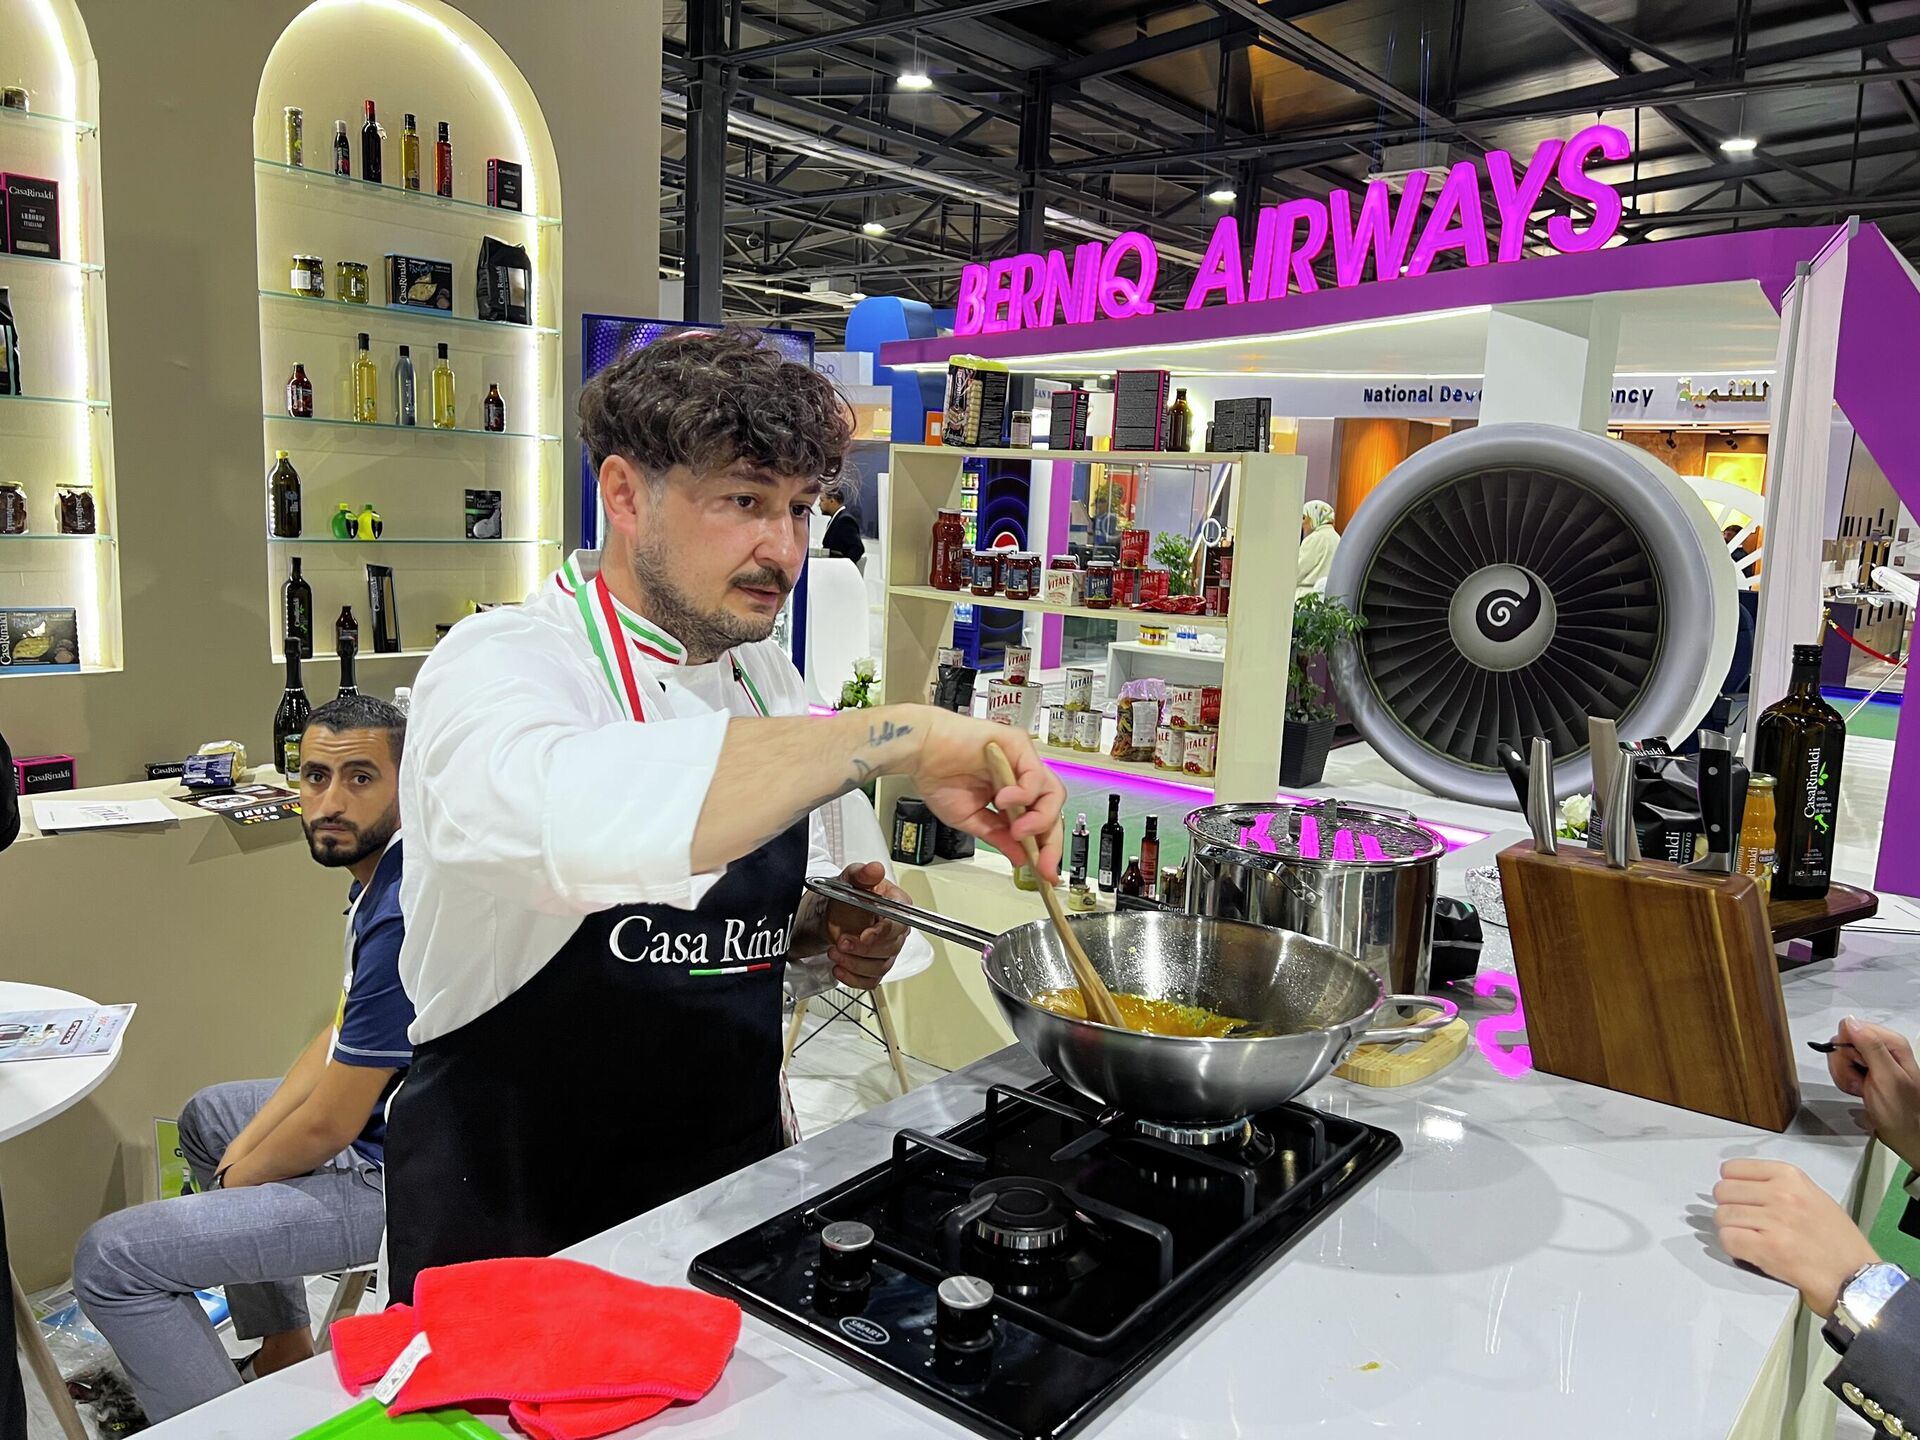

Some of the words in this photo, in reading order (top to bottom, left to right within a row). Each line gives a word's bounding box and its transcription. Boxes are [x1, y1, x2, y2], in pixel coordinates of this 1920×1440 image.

[8, 186, 54, 200] CasaRinaldi
[955, 231, 1159, 338] BERNIQ
[1184, 124, 1630, 310] AIRWAYS
[398, 257, 408, 304] CasaRinaldi
[1363, 384, 1433, 402] National
[1440, 385, 1483, 403] Dev
[1611, 388, 1654, 407] ncy
[1048, 575, 1069, 591] VITALE
[989, 692, 1022, 711] VITALE
[27, 769, 70, 783] CasaRinaldi
[152, 765, 184, 775] CasaRina
[1804, 747, 1821, 818] CasaRinaldi
[608, 915, 709, 964] Casa
[720, 912, 794, 963] Rinal
[849, 1320, 884, 1339] SMART
